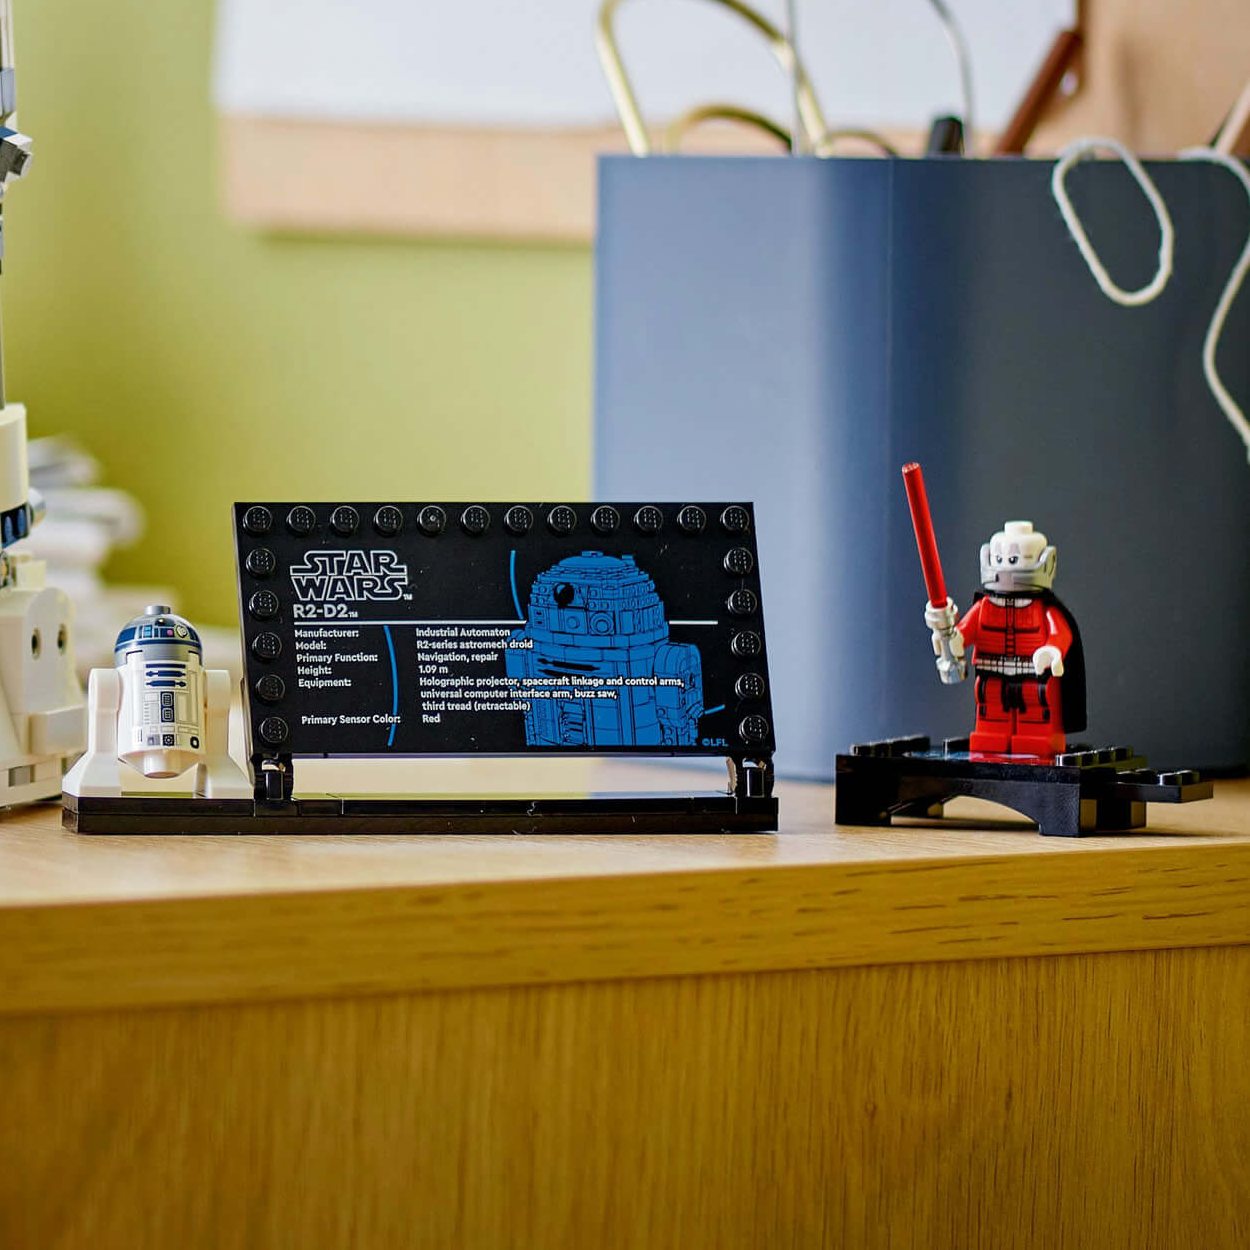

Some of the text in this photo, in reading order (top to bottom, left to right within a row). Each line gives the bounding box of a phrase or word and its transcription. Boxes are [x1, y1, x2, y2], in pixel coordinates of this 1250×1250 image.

[290, 550, 407, 576] STAR
[294, 628, 359, 638] Manufacturer:
[415, 627, 510, 637] Industrial Automaton
[295, 640, 327, 650] Model:
[416, 639, 533, 649] R2-series astromech droid
[296, 652, 378, 664] Primary Function:
[417, 651, 499, 663] Navigation, repair
[297, 665, 332, 676] Height:
[418, 664, 448, 674] 1.09 m
[298, 678, 352, 689] Equipment:
[419, 676, 685, 688] Holographic projector, spacecraft linkage and control arms,
[420, 688, 617, 700] universal computer interface arm, buzz saw,
[422, 701, 531, 711] third tread (retractable)
[301, 713, 401, 726] Primary Sensor Color:
[422, 713, 441, 723] Red
